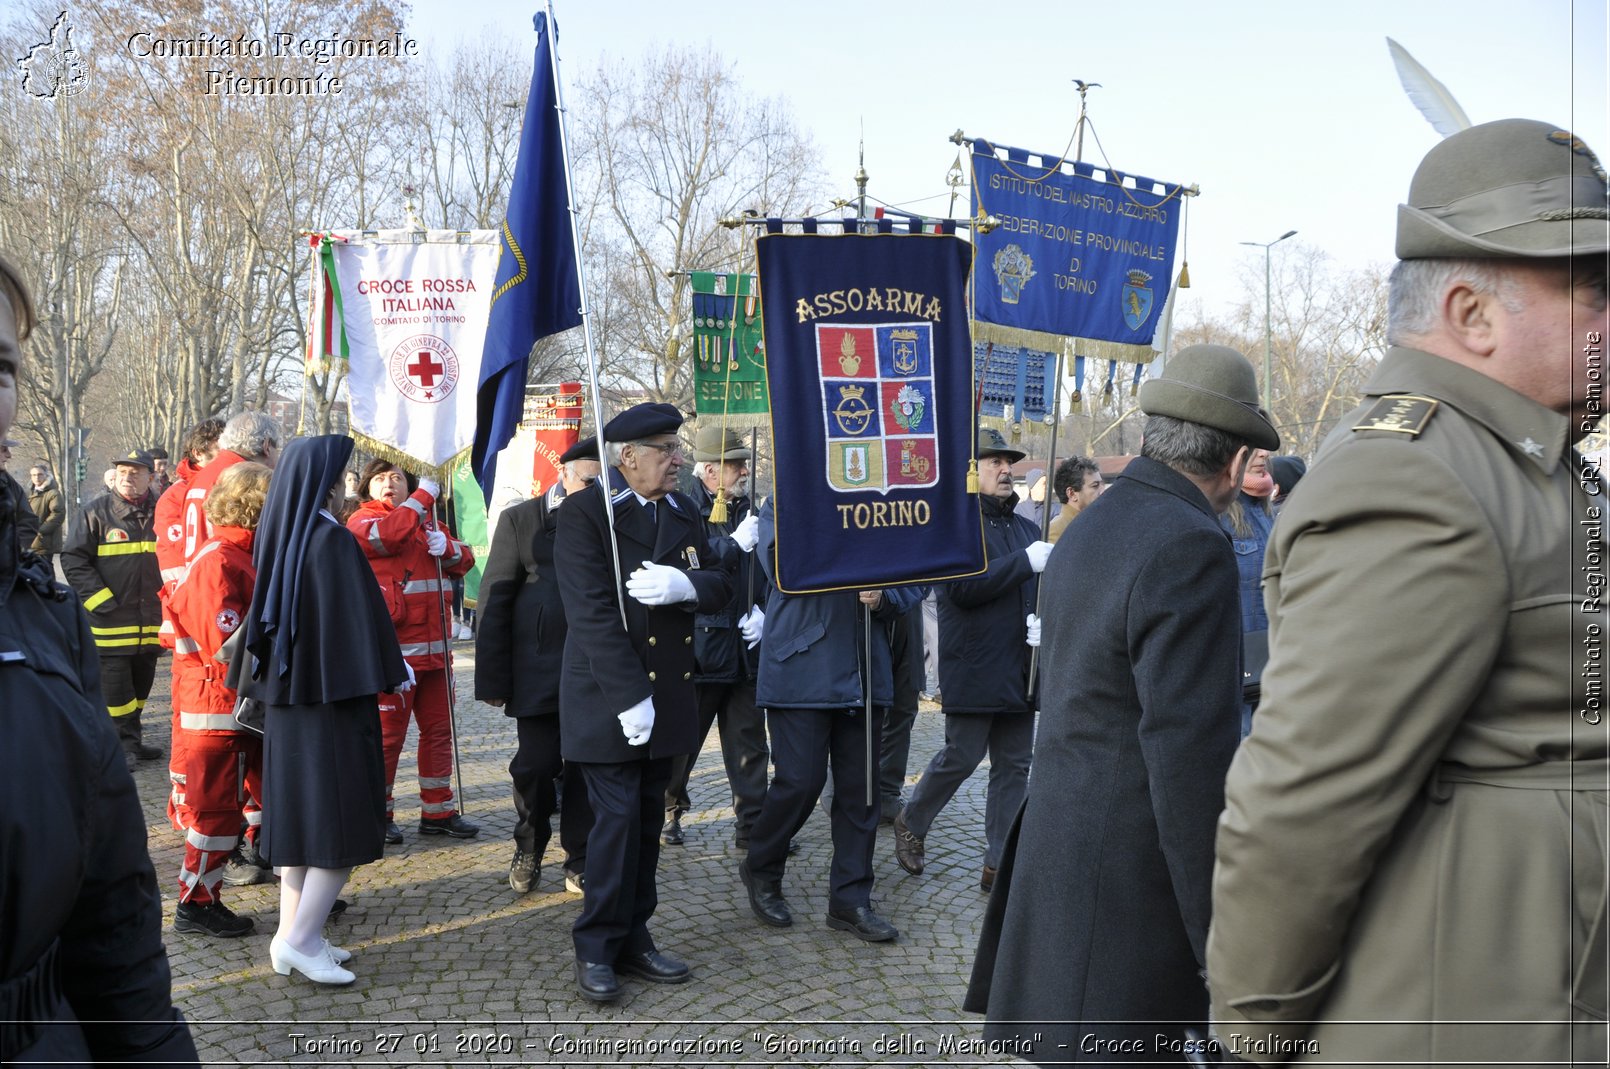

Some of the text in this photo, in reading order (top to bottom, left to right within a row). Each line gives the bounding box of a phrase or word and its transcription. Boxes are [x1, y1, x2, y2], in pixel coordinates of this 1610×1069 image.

[989, 173, 1167, 224] ISTITUTO DEL NASTRO AZZURRO
[995, 213, 1165, 261] FEDERAZIONE PROVINCIALE
[1070, 257, 1082, 273] DI
[357, 279, 477, 295] CROCE ROSSA
[1053, 273, 1097, 295] TORINO
[382, 297, 455, 312] ITALIANA
[796, 288, 941, 323] ASSOARMA
[374, 316, 420, 325] COMITATO
[702, 381, 762, 400] SEZIONE
[837, 500, 931, 529] TORINO
